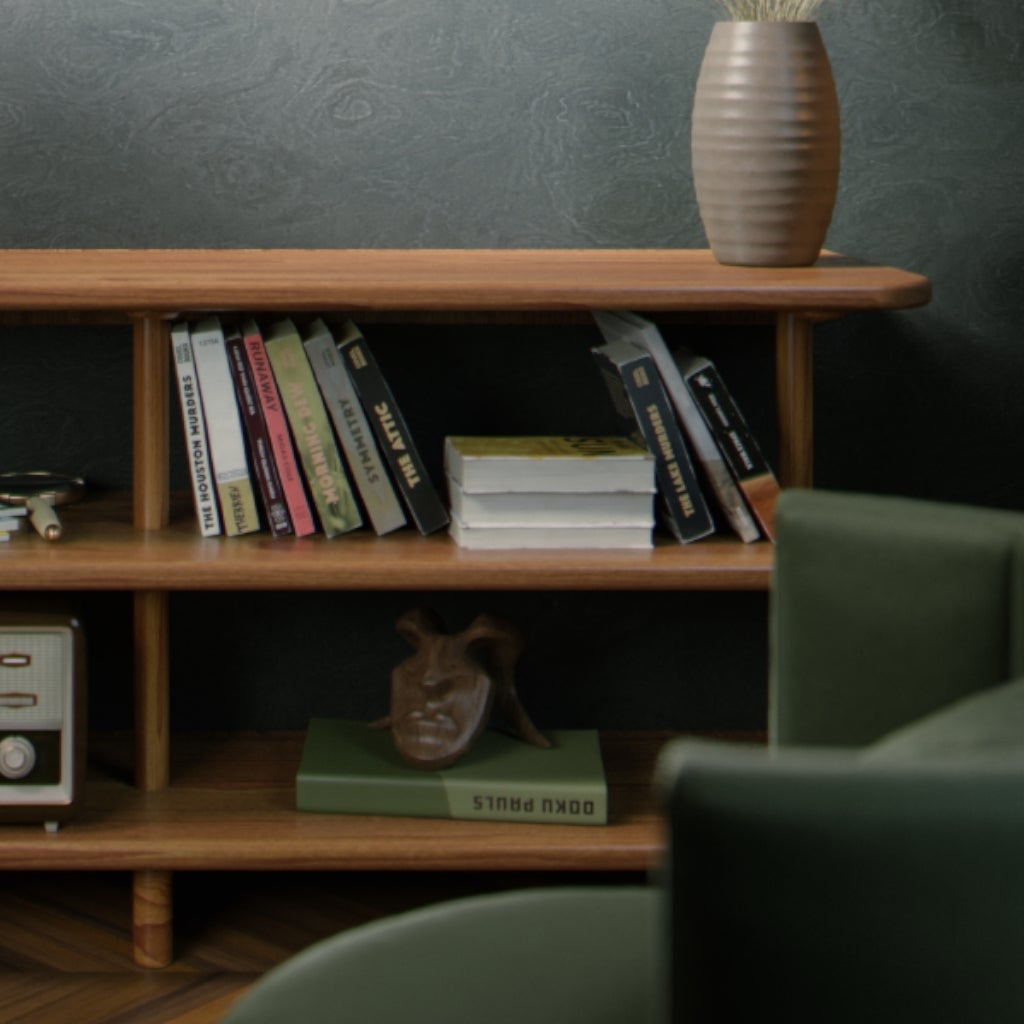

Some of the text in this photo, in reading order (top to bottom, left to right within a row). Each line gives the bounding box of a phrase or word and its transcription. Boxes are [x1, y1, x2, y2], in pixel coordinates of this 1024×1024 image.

[182, 375, 200, 436] MURDERS
[249, 341, 279, 412] RUNAWAY
[289, 381, 340, 504] MORNING DEW
[338, 398, 380, 485] SYMMETRY
[374, 401, 422, 489] THE ATTIC
[645, 403, 676, 462] MURDERS
[193, 440, 210, 503] HOUSTON
[202, 505, 215, 530] THE
[678, 493, 697, 518] THE
[472, 794, 535, 813] PAULS
